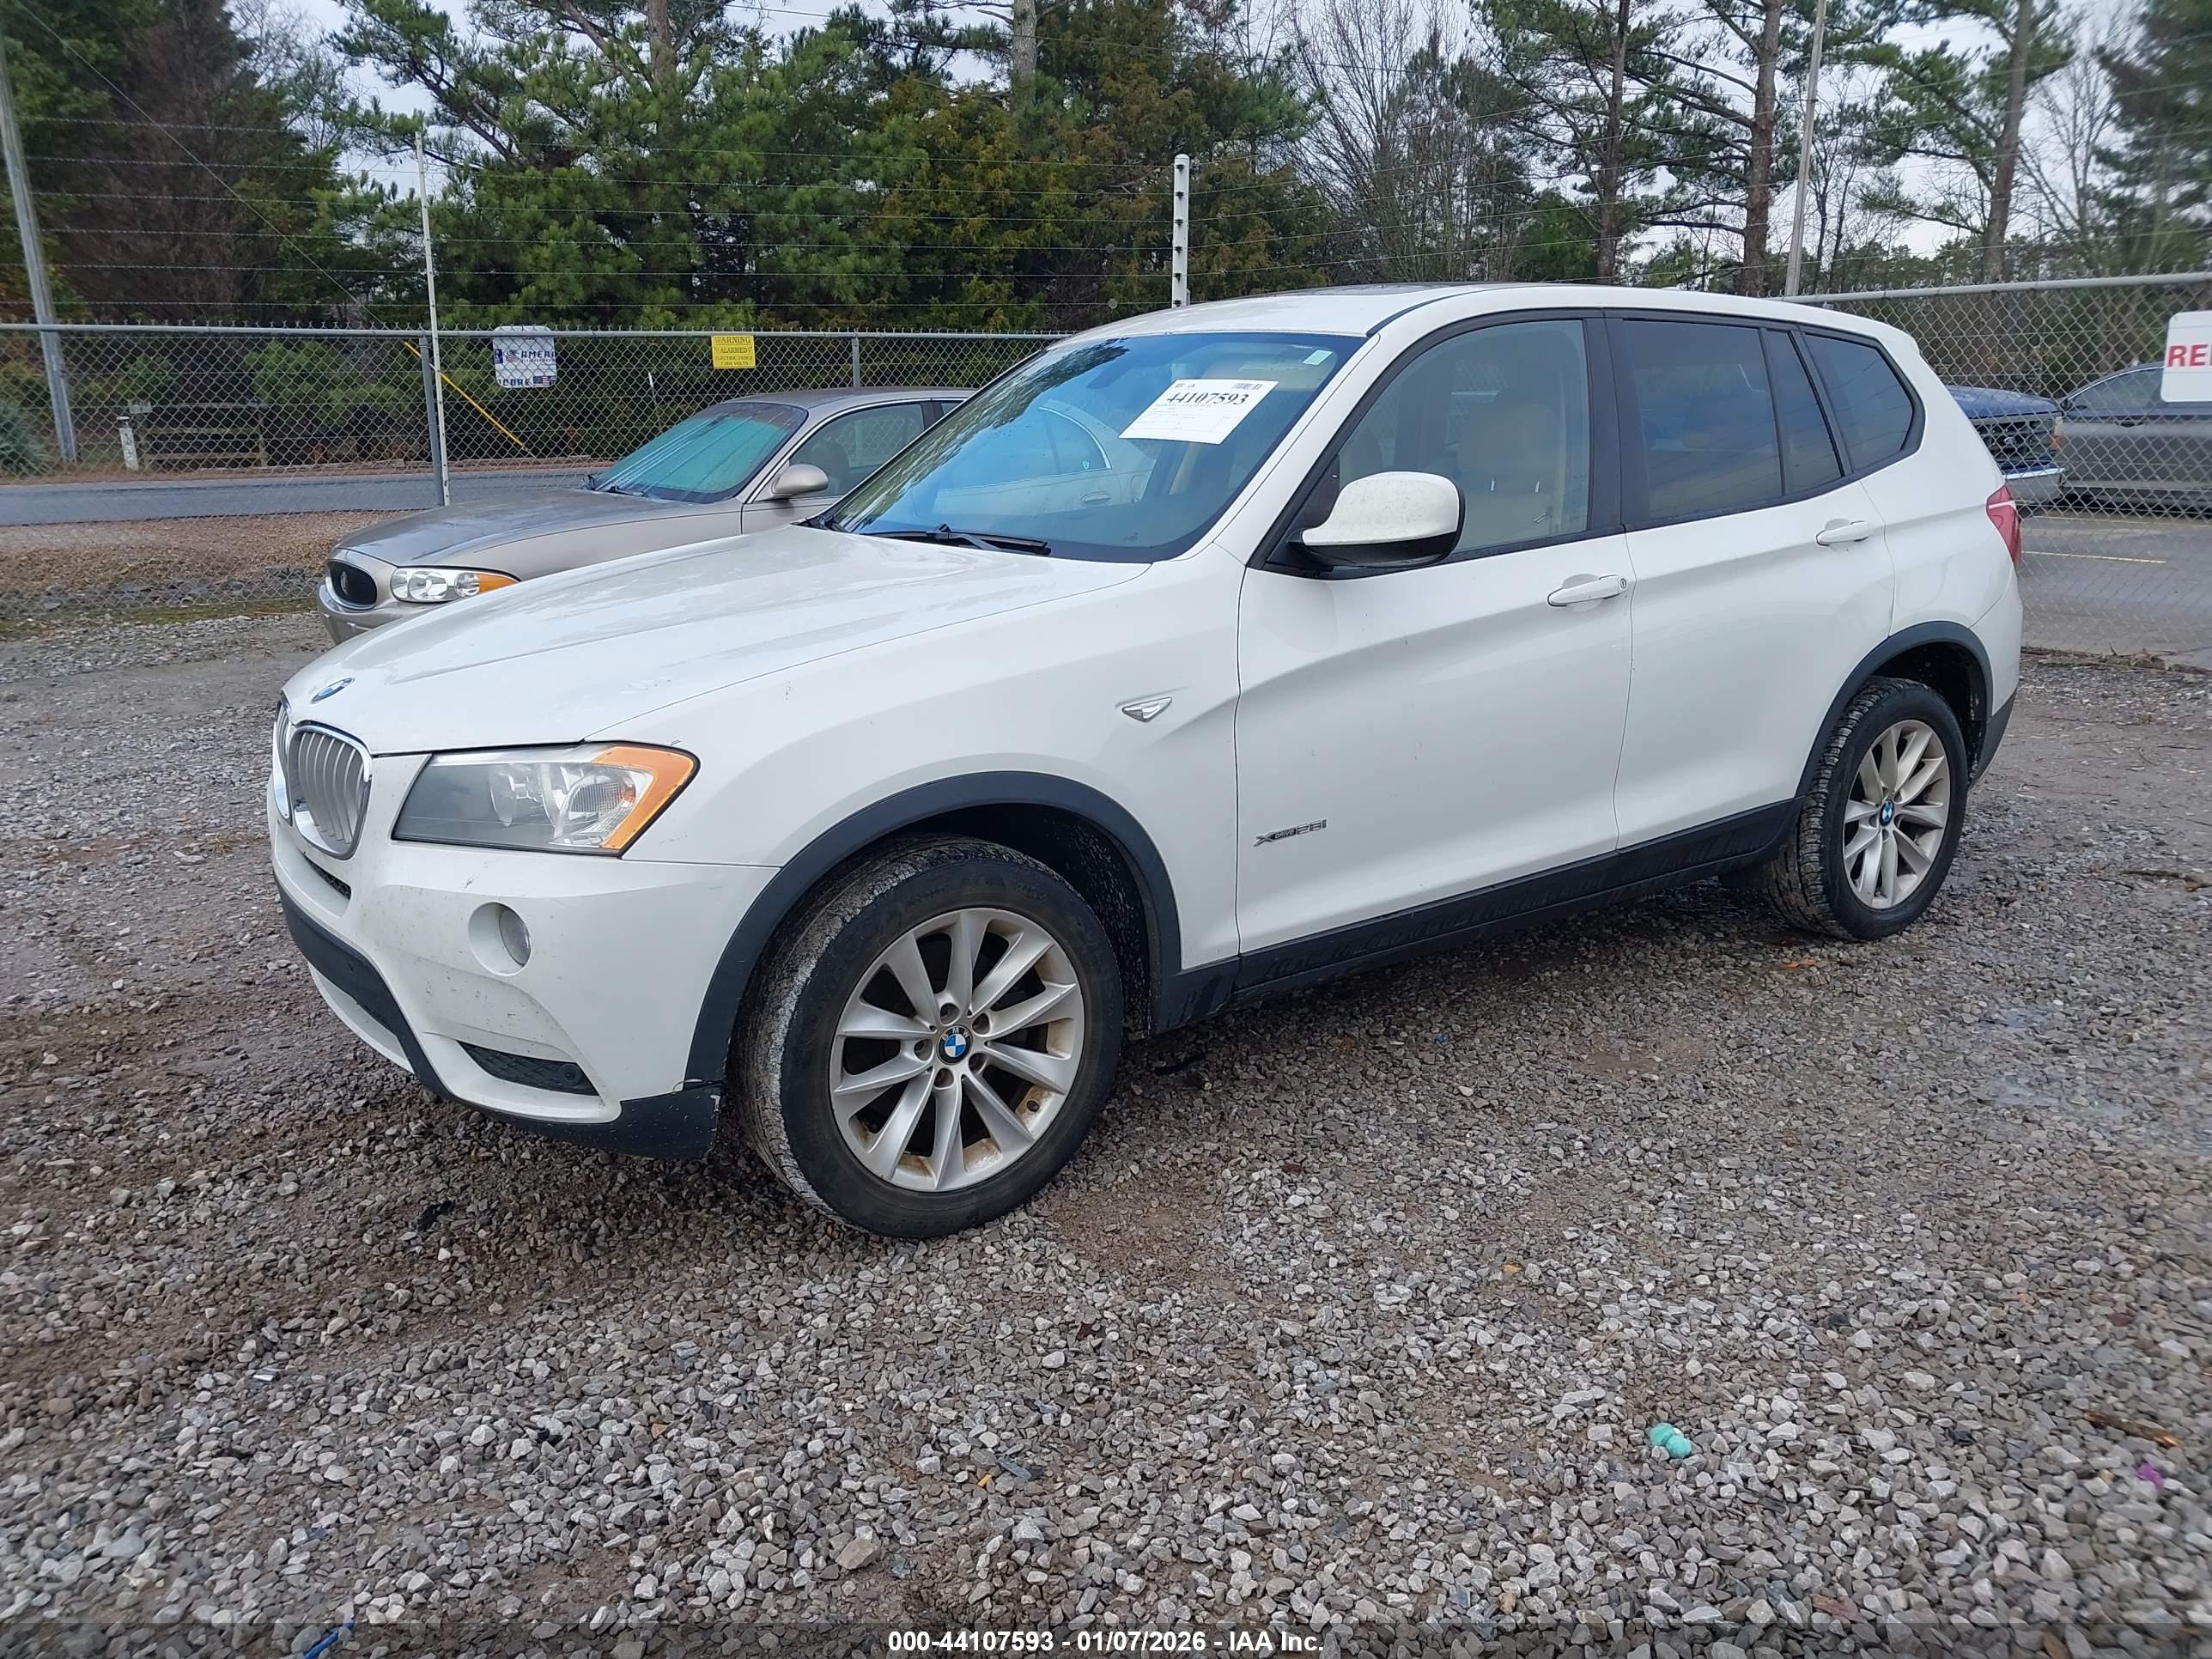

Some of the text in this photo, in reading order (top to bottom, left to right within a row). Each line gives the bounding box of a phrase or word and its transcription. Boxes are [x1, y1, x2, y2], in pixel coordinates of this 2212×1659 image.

[2167, 343, 2212, 368] RE
[1167, 392, 1249, 405] 44107593
[942, 1027, 969, 1041] BMW
